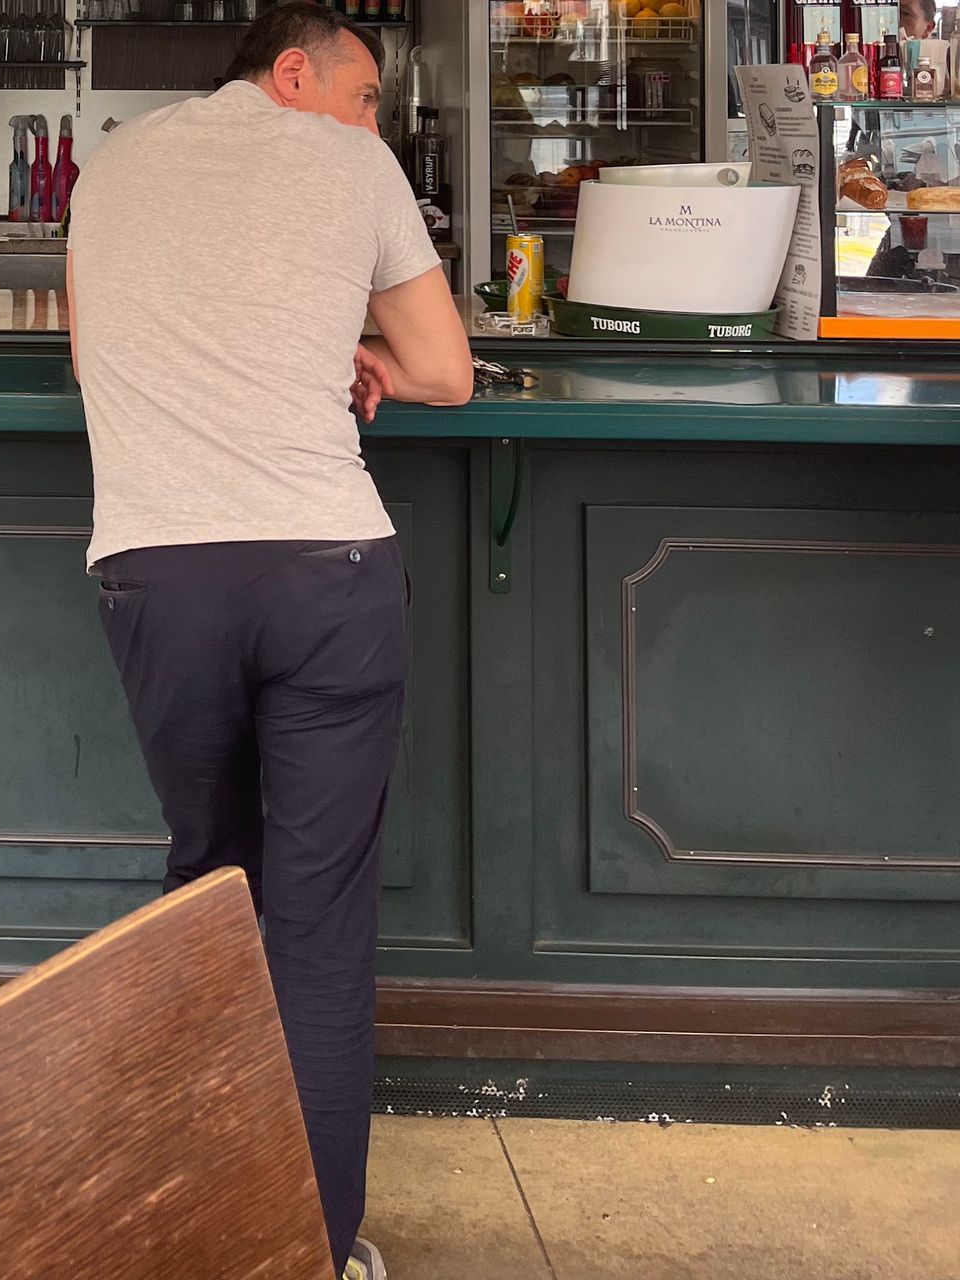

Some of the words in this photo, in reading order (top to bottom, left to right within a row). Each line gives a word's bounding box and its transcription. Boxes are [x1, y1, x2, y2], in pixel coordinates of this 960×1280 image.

[425, 156, 434, 191] V-SYRUP
[649, 217, 662, 226] LA
[665, 217, 722, 229] MONTINA
[590, 316, 640, 334] TUBORG
[707, 324, 753, 338] TUBORG
